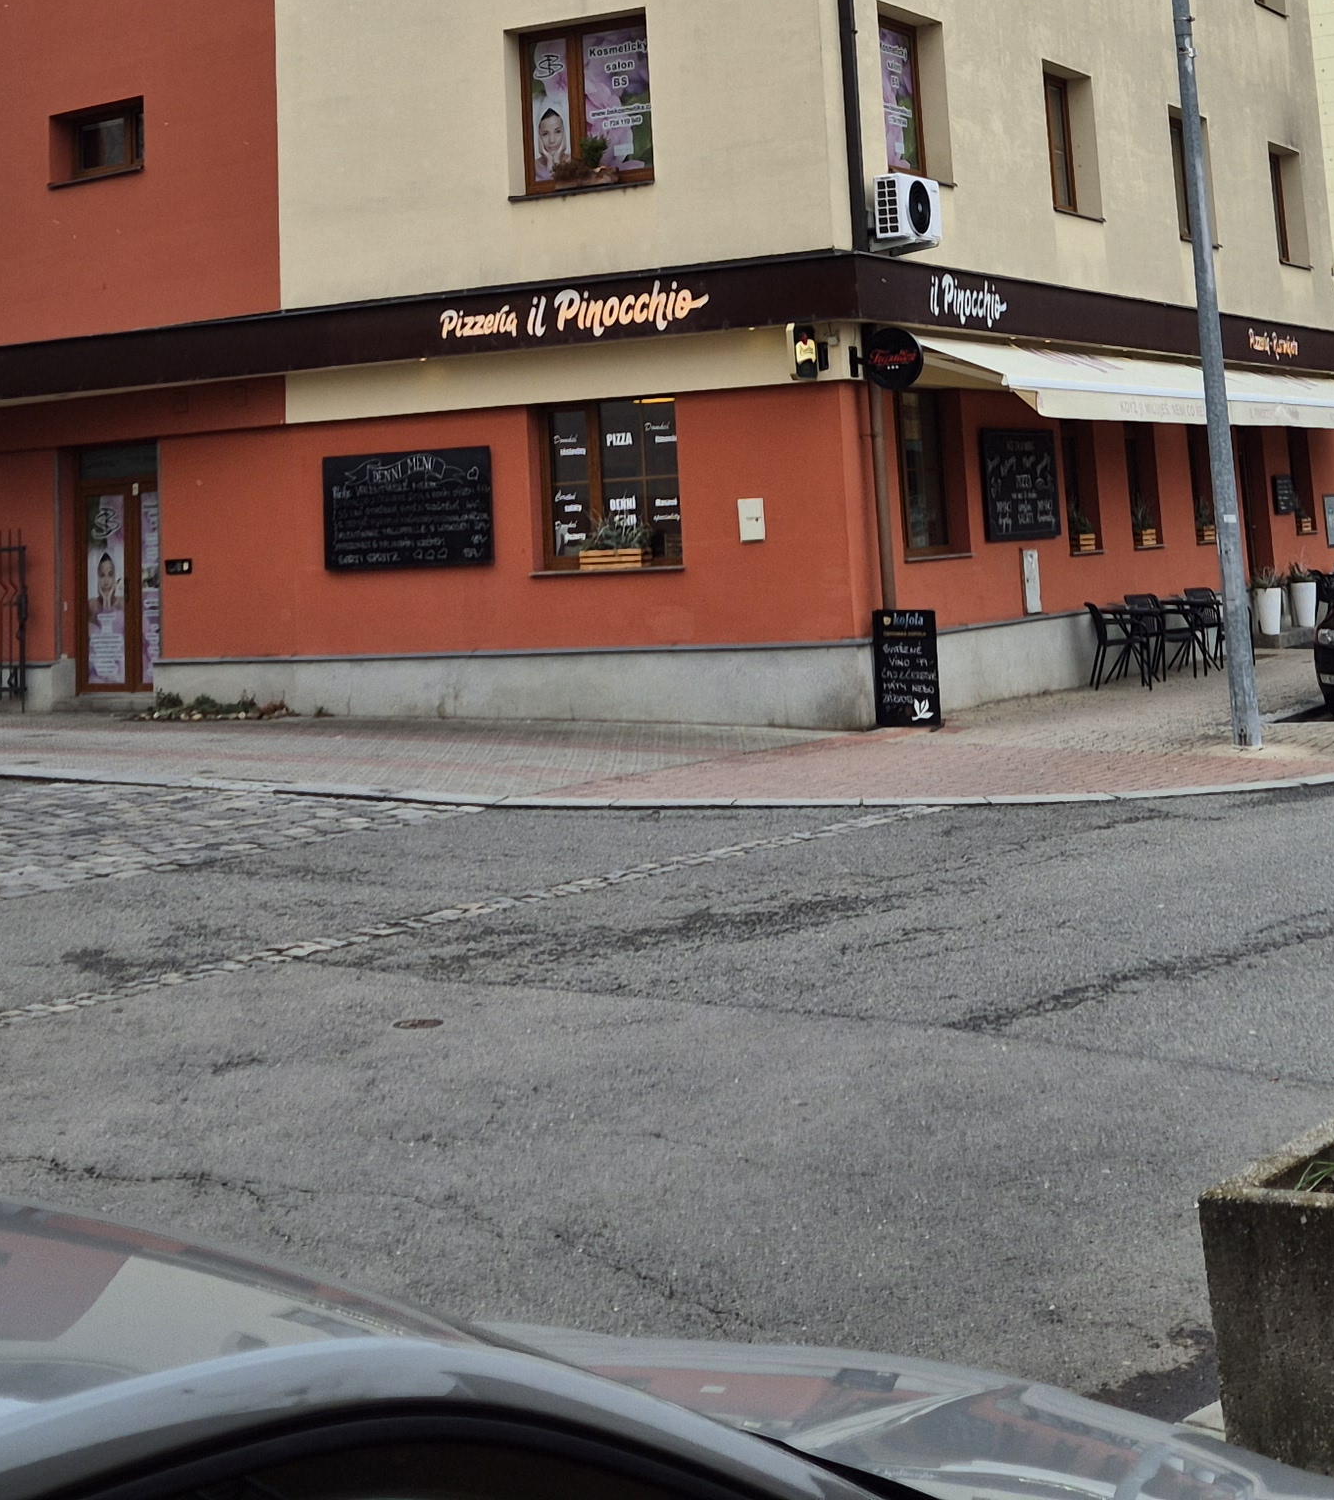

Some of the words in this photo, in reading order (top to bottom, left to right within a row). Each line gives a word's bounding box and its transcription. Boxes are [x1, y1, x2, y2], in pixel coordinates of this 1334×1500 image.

[589, 40, 648, 57] Kosmetický
[605, 61, 634, 72] salon
[614, 77, 628, 88] BS
[929, 275, 939, 317] il
[941, 273, 1008, 328] Pinocchio
[440, 305, 517, 339] Pizzeria
[527, 296, 547, 337] il
[554, 280, 709, 337] Pinocchio
[606, 432, 633, 446] PIZZA
[407, 455, 436, 474] MENU
[893, 612, 924, 629] kofola
[888, 655, 910, 667] VÍNO
